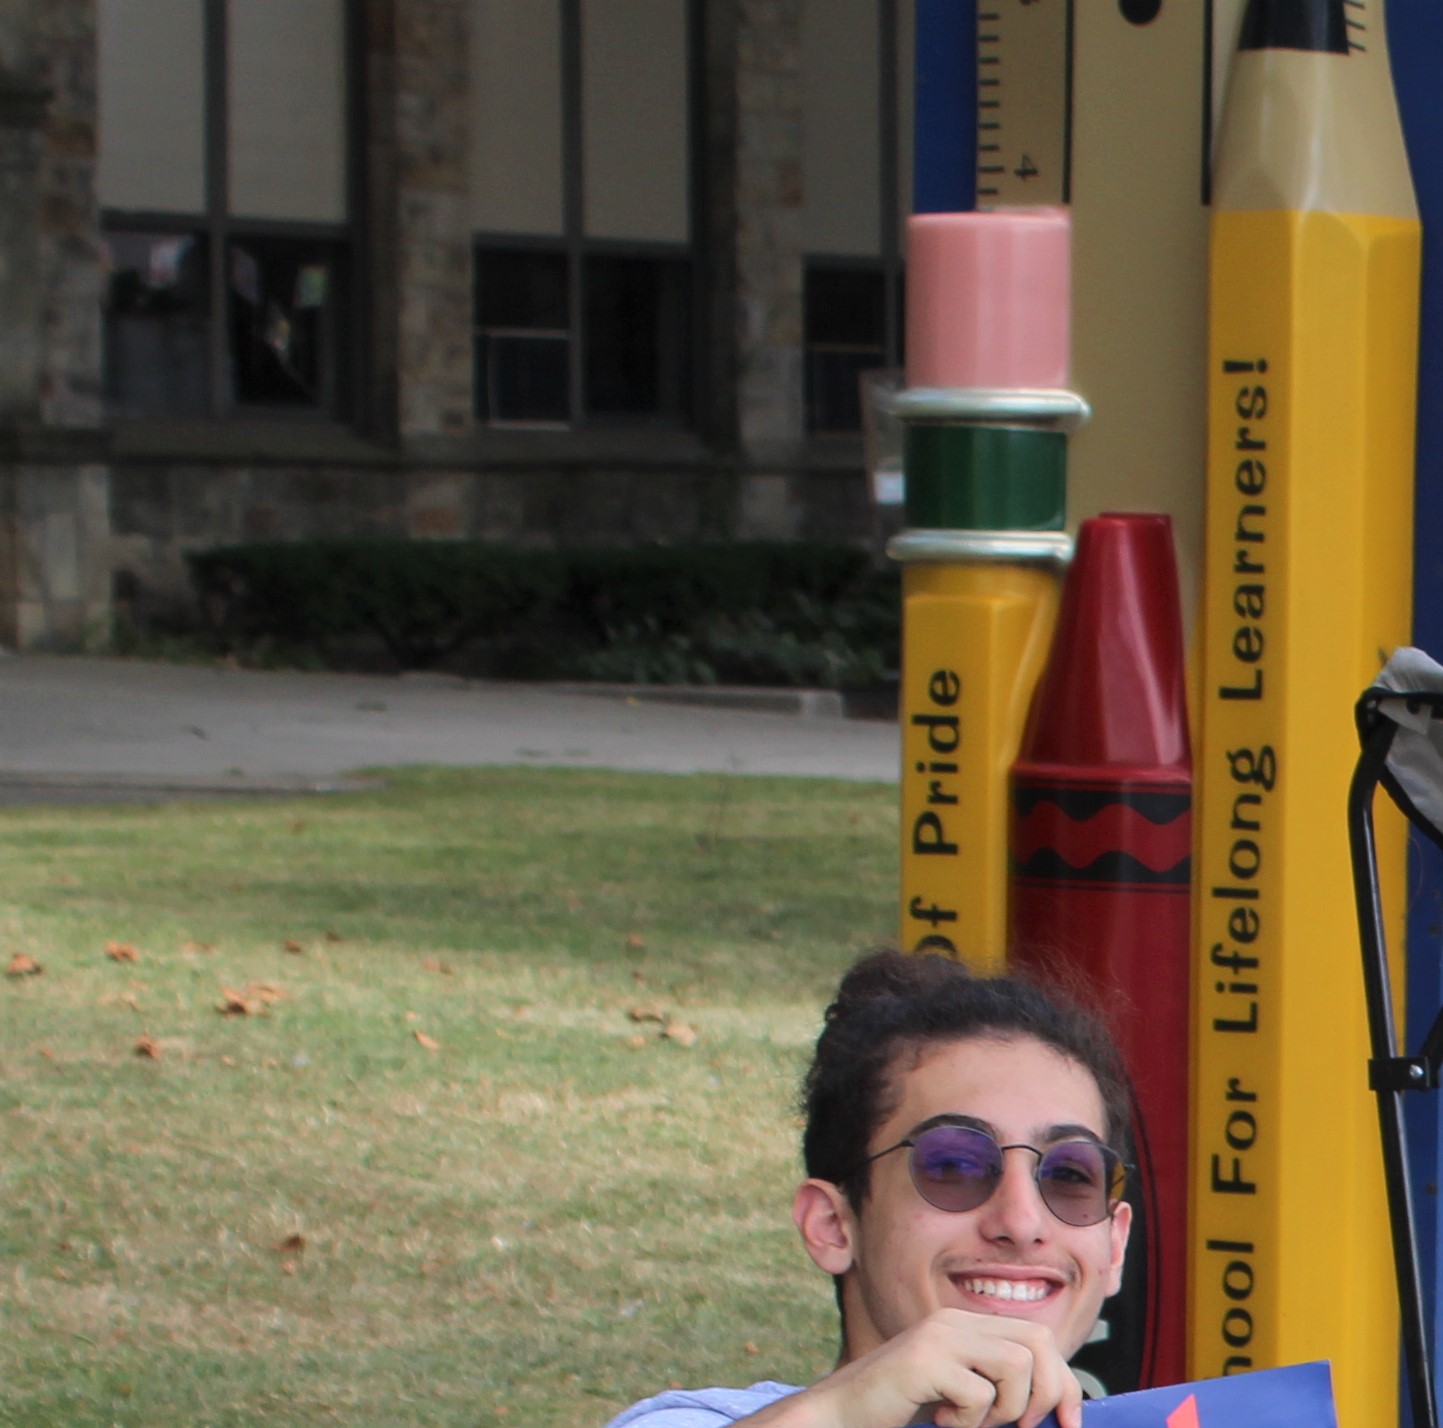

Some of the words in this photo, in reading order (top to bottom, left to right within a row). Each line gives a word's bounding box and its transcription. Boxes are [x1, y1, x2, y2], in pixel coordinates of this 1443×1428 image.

[1218, 359, 1269, 700] Learners!
[911, 669, 961, 855] Pride
[1211, 743, 1277, 1034] Lifelong
[1210, 1077, 1259, 1195] For
